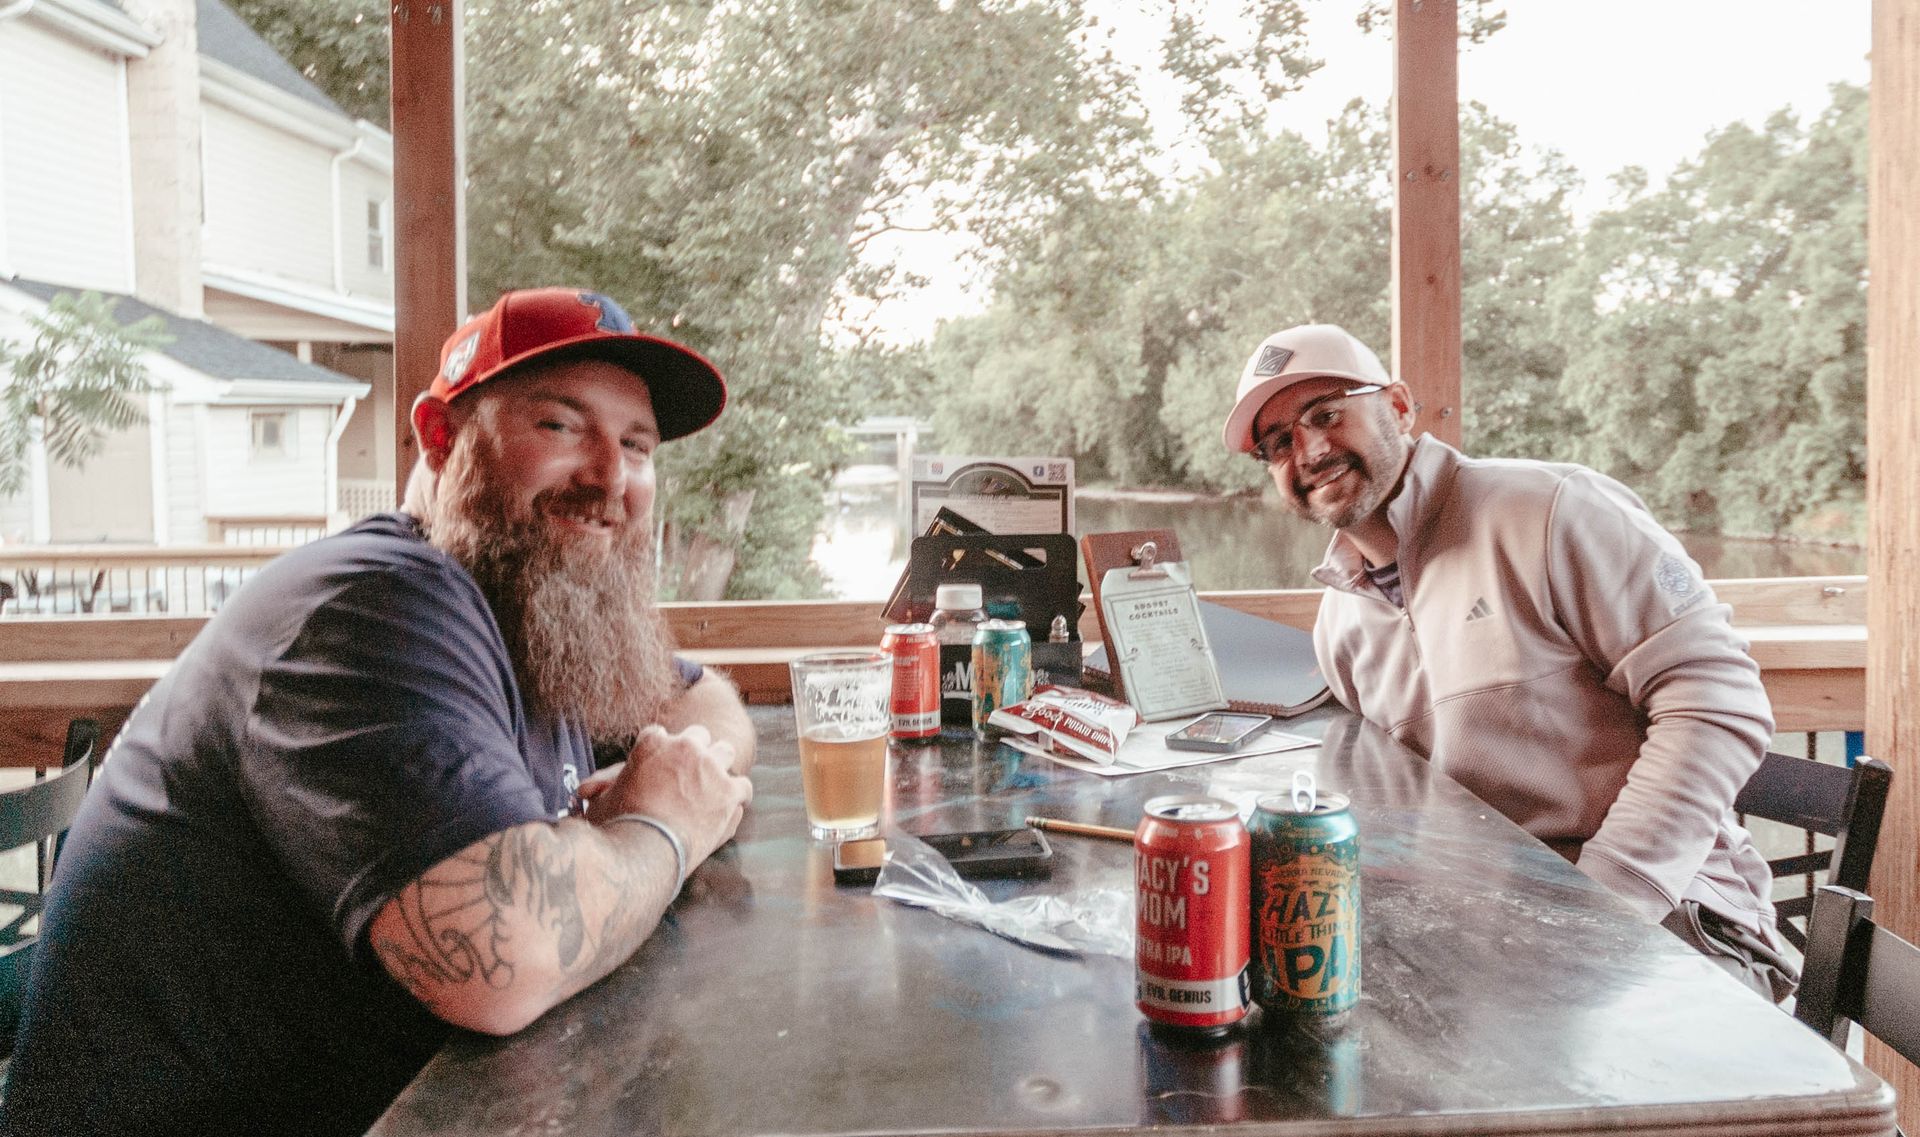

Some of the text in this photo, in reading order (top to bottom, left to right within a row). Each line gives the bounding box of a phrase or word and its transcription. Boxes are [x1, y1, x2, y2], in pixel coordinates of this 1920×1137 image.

[1129, 608, 1178, 620] COCKTAILS
[1134, 600, 1168, 610] AUGUST
[1136, 852, 1210, 895] ACY'S
[1265, 889, 1349, 923] HAZY
[1264, 934, 1348, 993] IPA
[1169, 988, 1212, 1004] GENIUS
